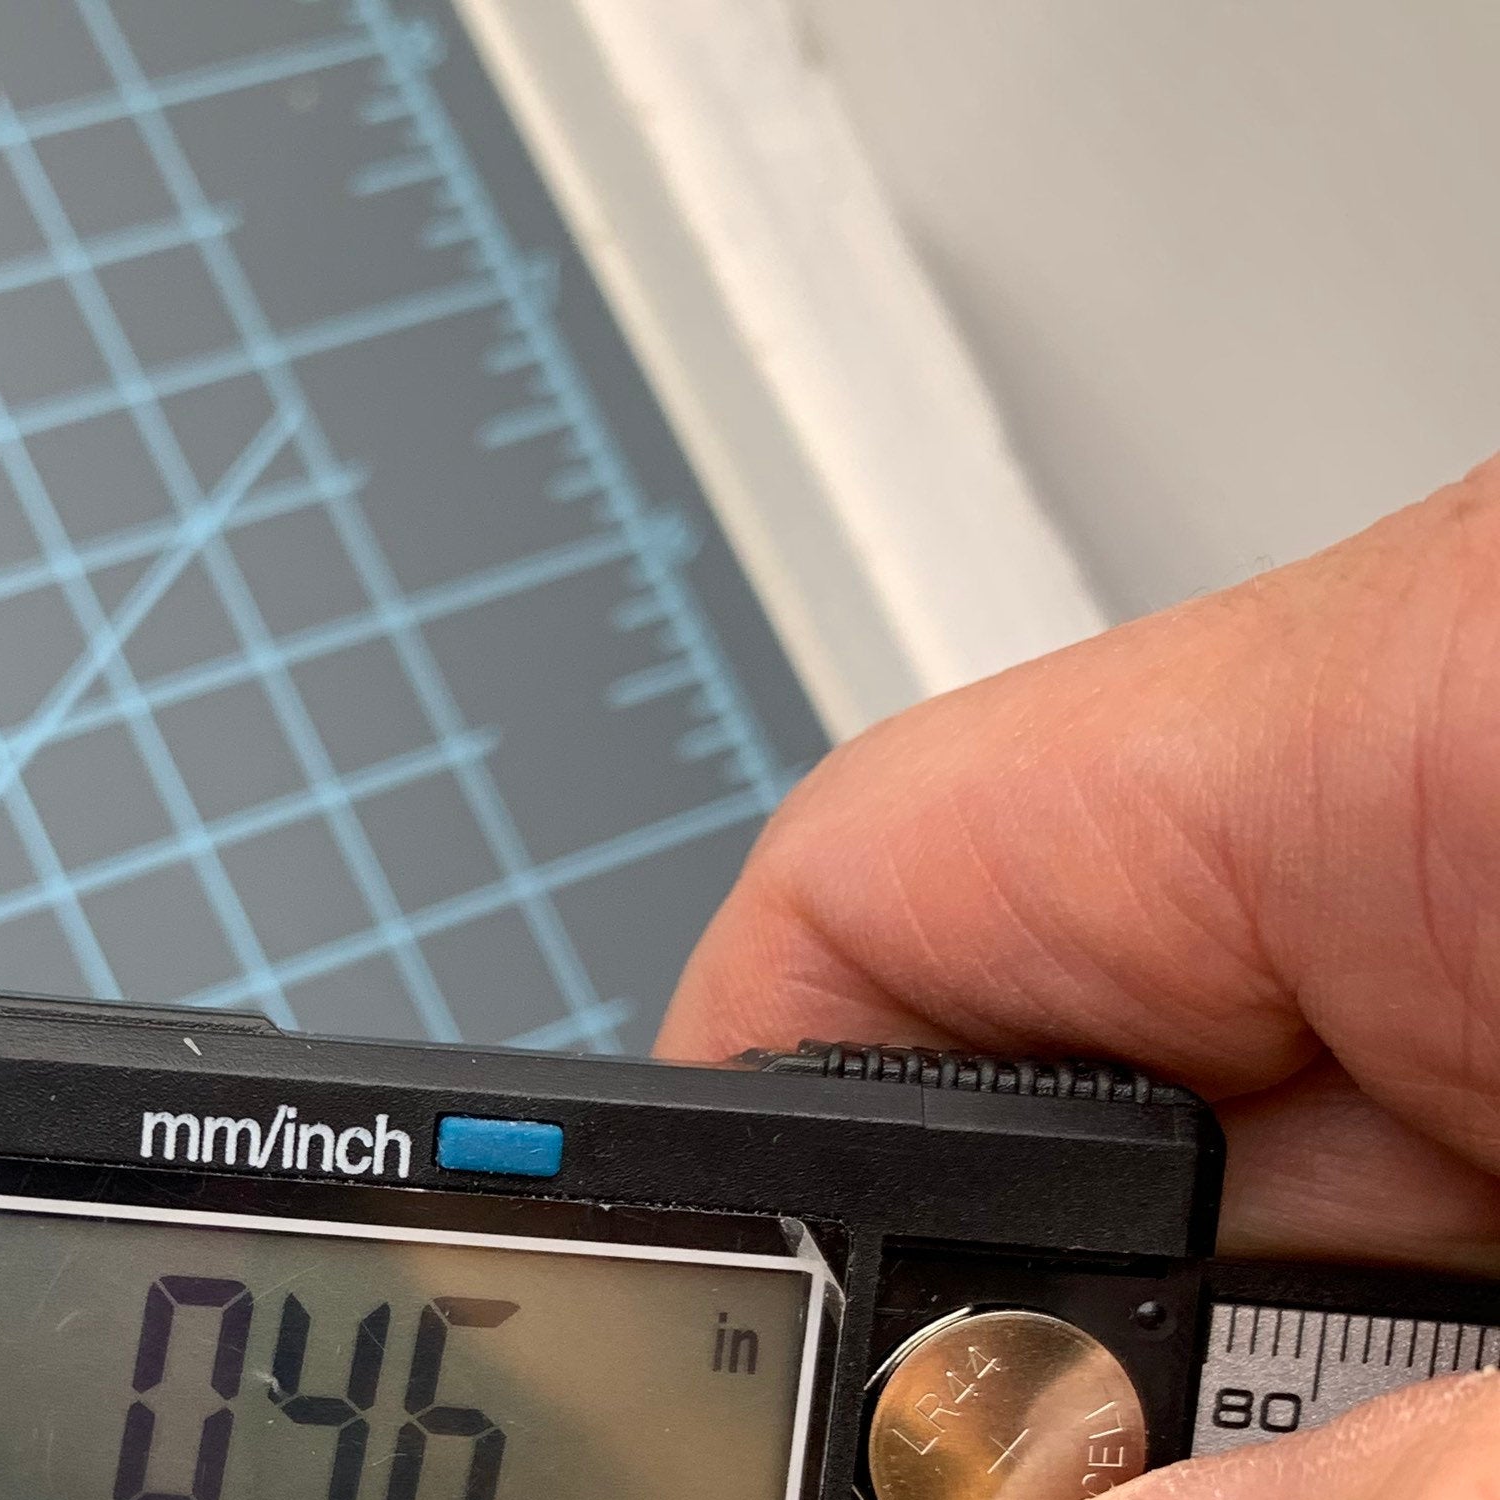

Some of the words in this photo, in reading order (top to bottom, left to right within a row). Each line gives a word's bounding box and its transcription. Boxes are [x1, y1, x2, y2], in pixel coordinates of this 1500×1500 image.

[140, 1103, 412, 1179] mm/inch
[712, 1312, 759, 1376] in
[892, 1345, 1001, 1456] LR44
[1212, 1387, 1301, 1433] 80
